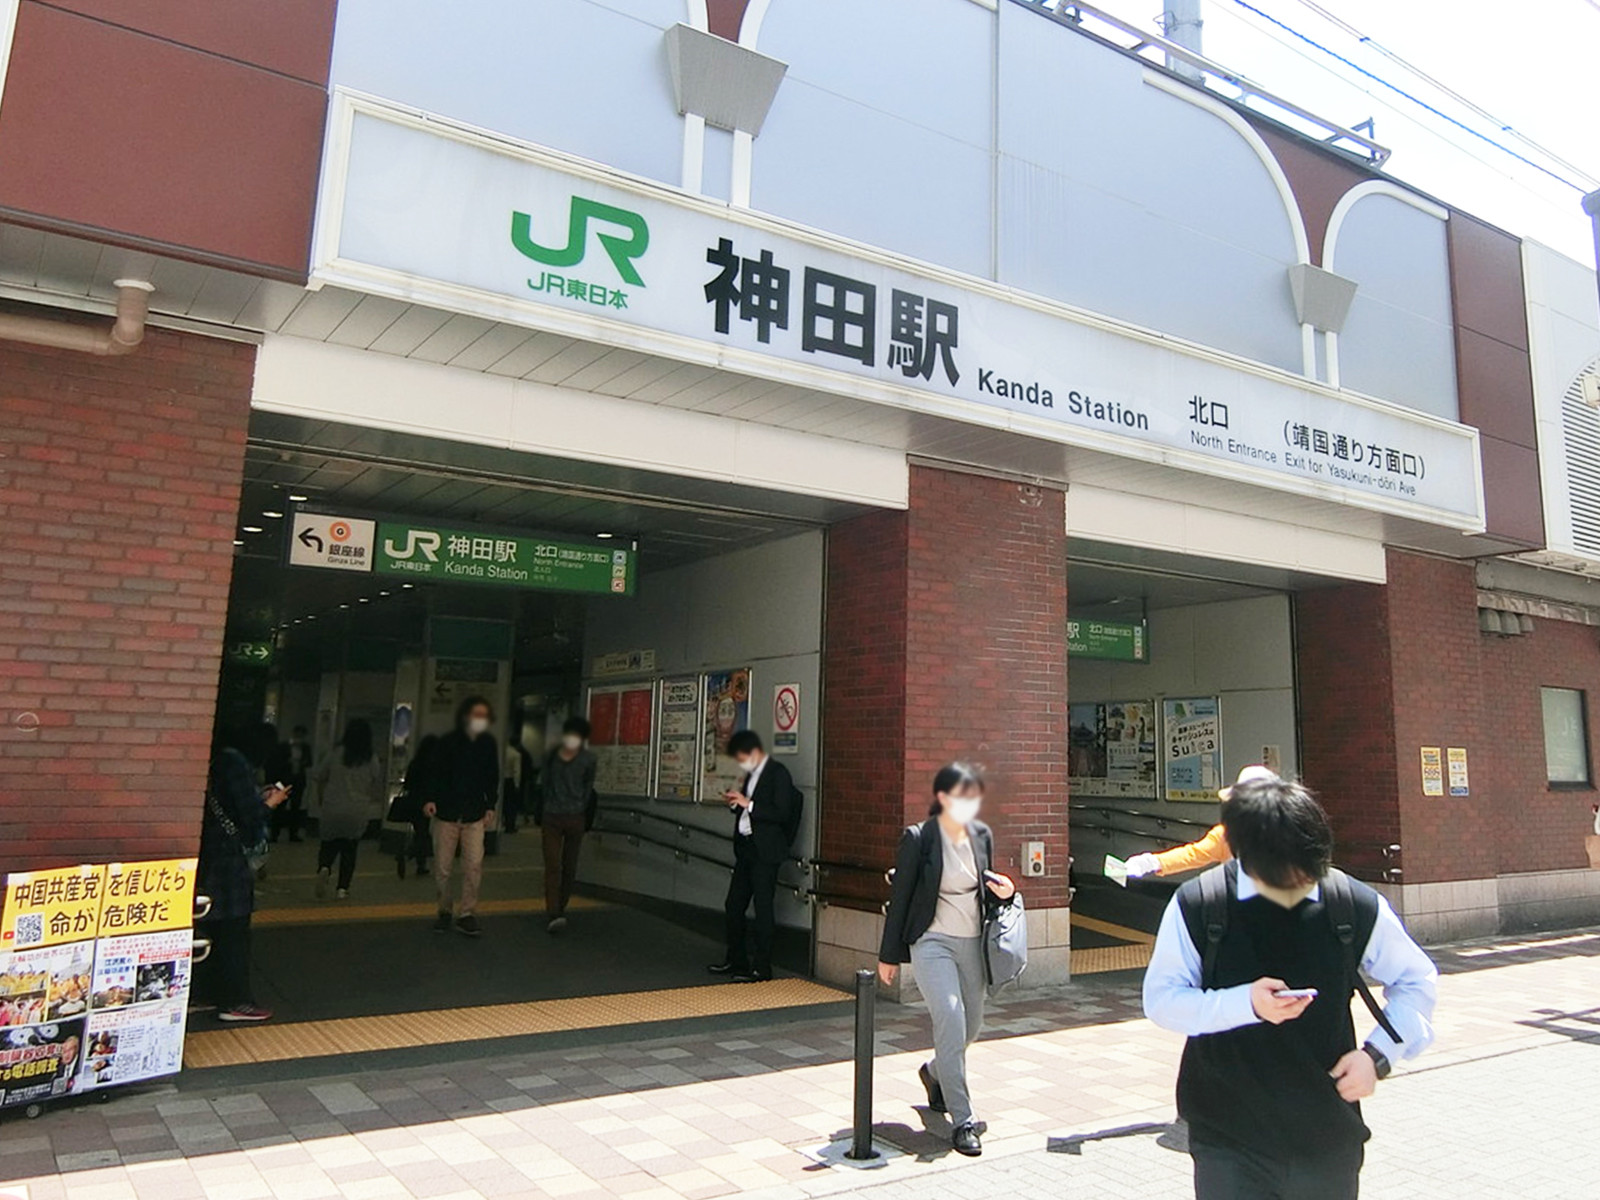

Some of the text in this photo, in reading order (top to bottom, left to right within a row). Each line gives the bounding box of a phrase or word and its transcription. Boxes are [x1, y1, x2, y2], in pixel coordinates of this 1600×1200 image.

[511, 195, 649, 288] JR
[527, 272, 630, 310] JR東日本
[703, 237, 960, 388] 神田駅
[978, 367, 1149, 430] Kanda Station
[1188, 395, 1229, 430] 北口
[1191, 430, 1223, 450] North
[1228, 438, 1277, 463] Entrance
[1285, 452, 1306, 470] Exit
[1308, 458, 1323, 474] for
[1399, 481, 1417, 496] Ave
[327, 556, 366, 567] Ginza Line
[328, 544, 366, 558] 銀座線
[384, 529, 441, 562] JR
[447, 534, 517, 563] 神田駅
[534, 544, 558, 557] 北口
[390, 560, 433, 572] JR東日本
[444, 561, 484, 577] Kanda
[487, 564, 529, 581] Station
